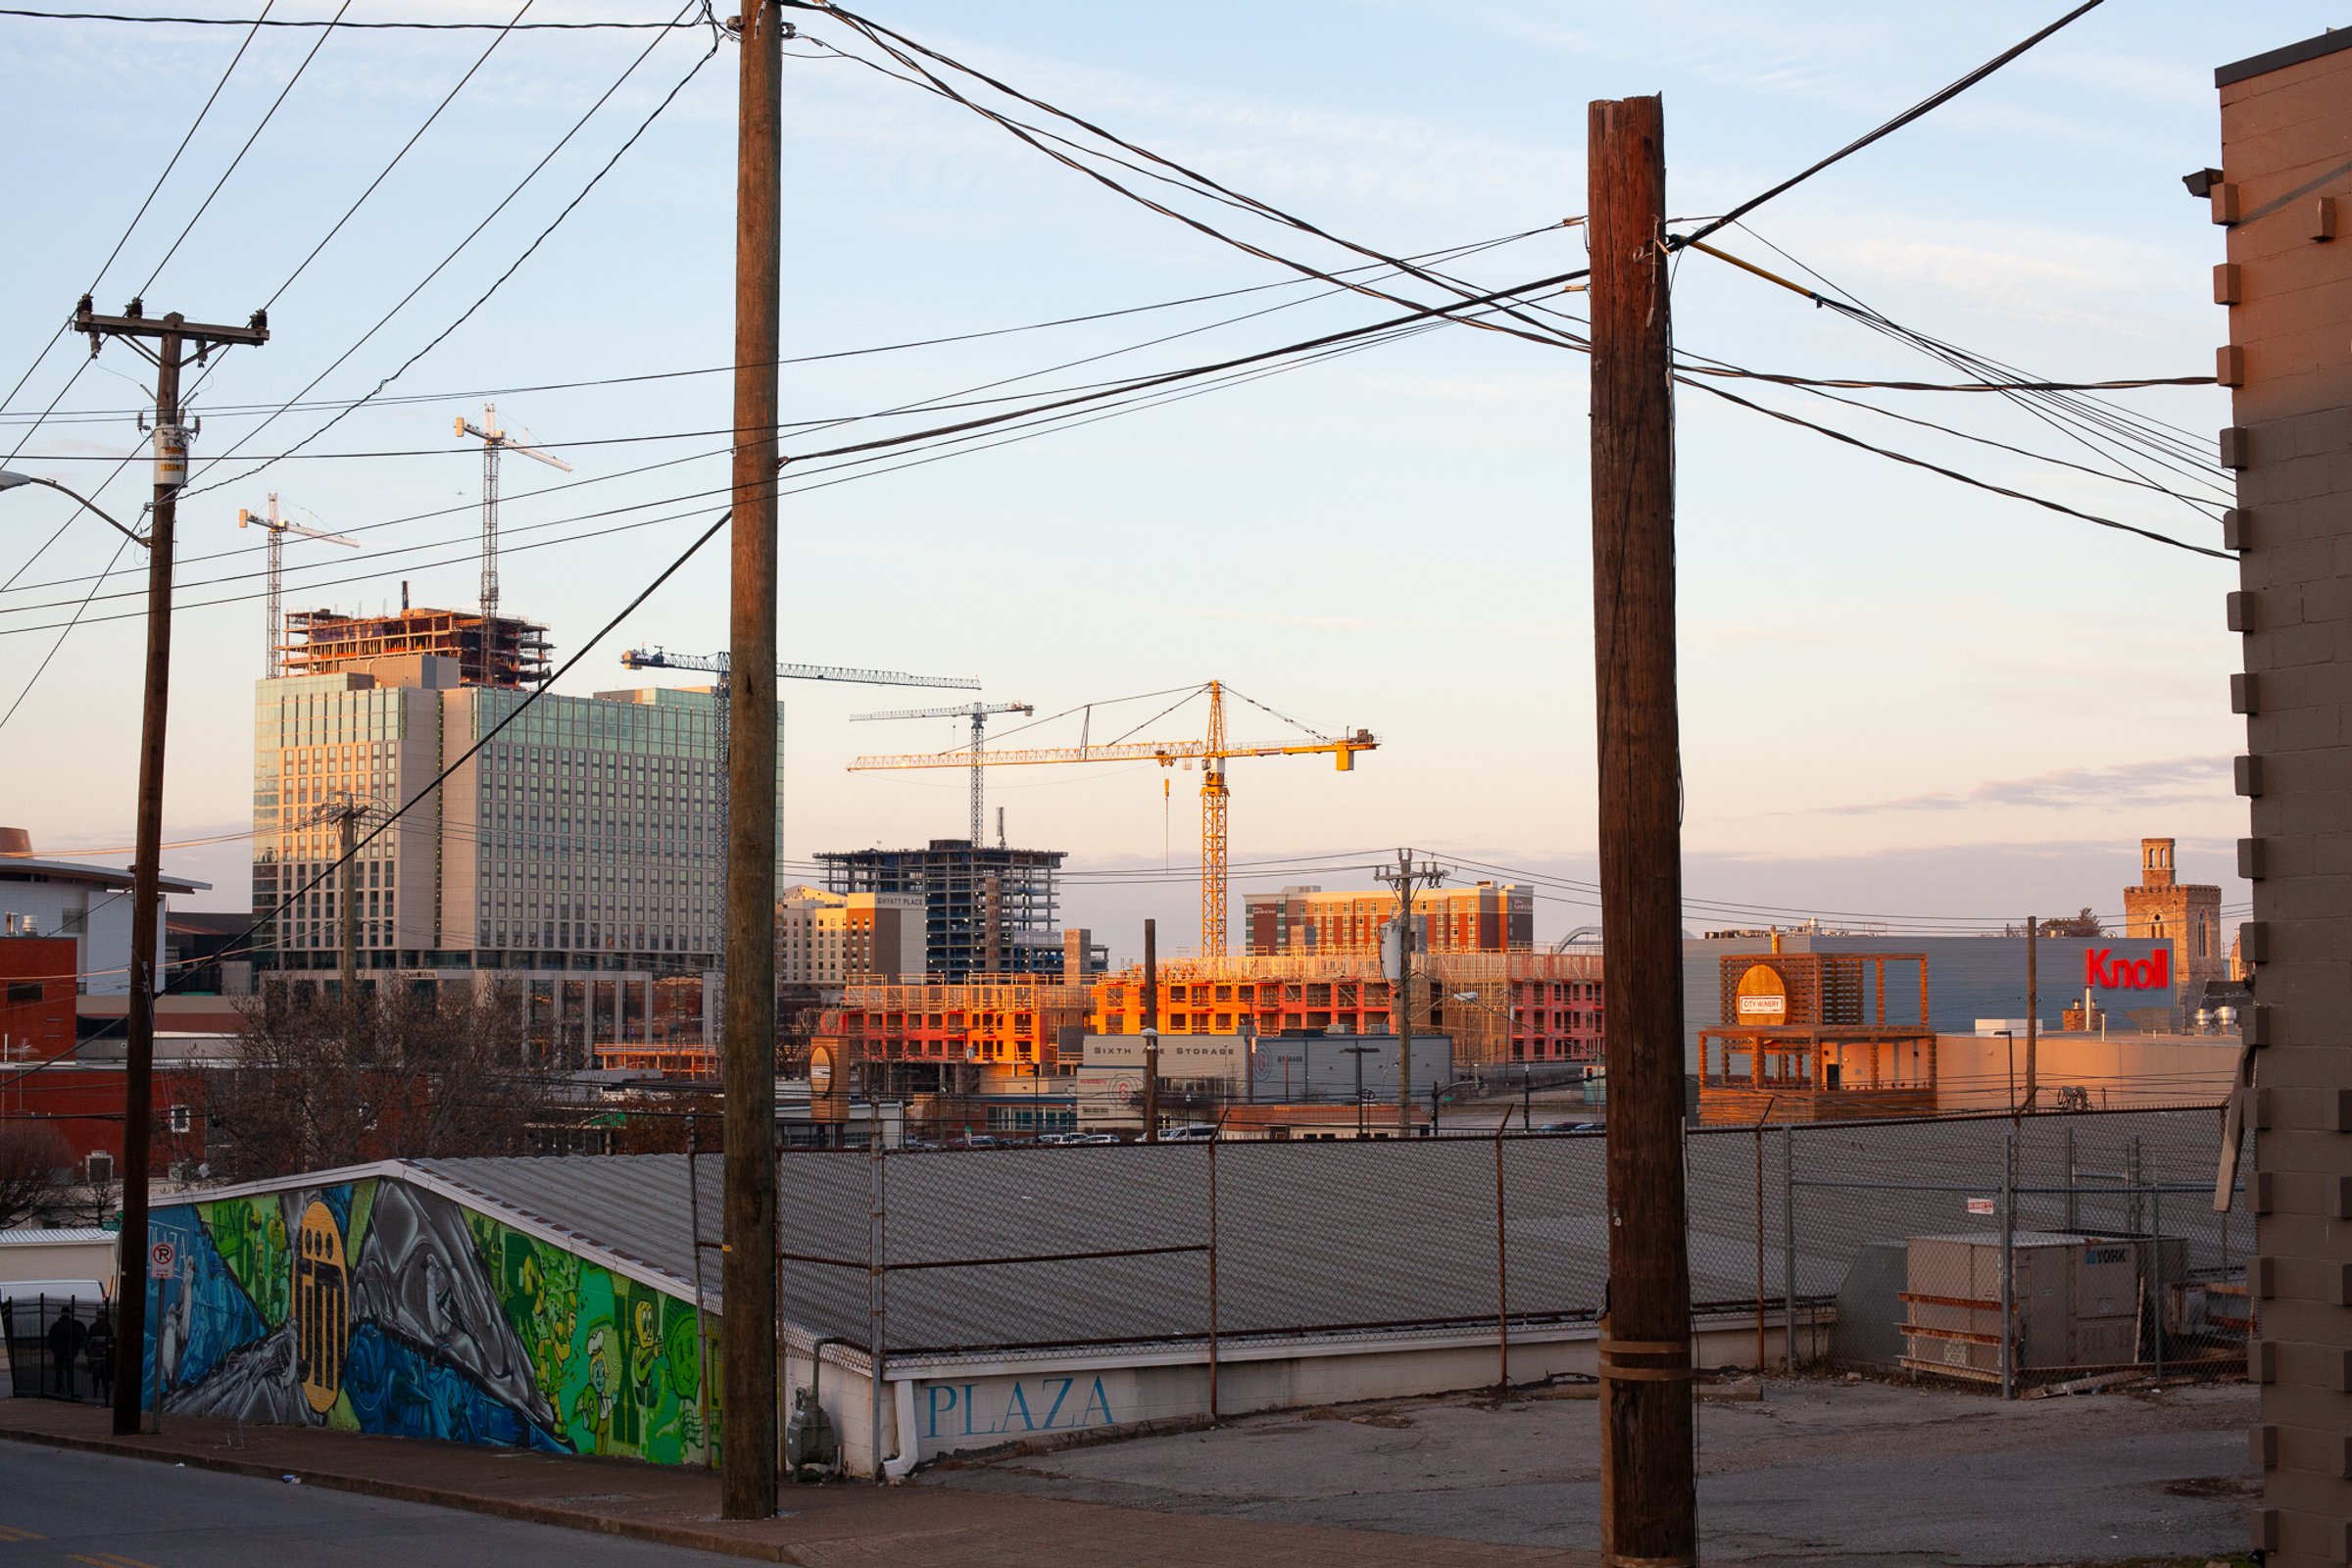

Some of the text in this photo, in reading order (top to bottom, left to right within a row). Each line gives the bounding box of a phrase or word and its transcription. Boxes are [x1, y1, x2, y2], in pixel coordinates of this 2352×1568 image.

[2085, 948, 2168, 990] Knoll
[1176, 1047, 1235, 1055] STORAGE
[1277, 1055, 1303, 1064] STRAGE
[2097, 1249, 2127, 1263] YORK
[924, 1375, 1115, 1439] PLAZA
